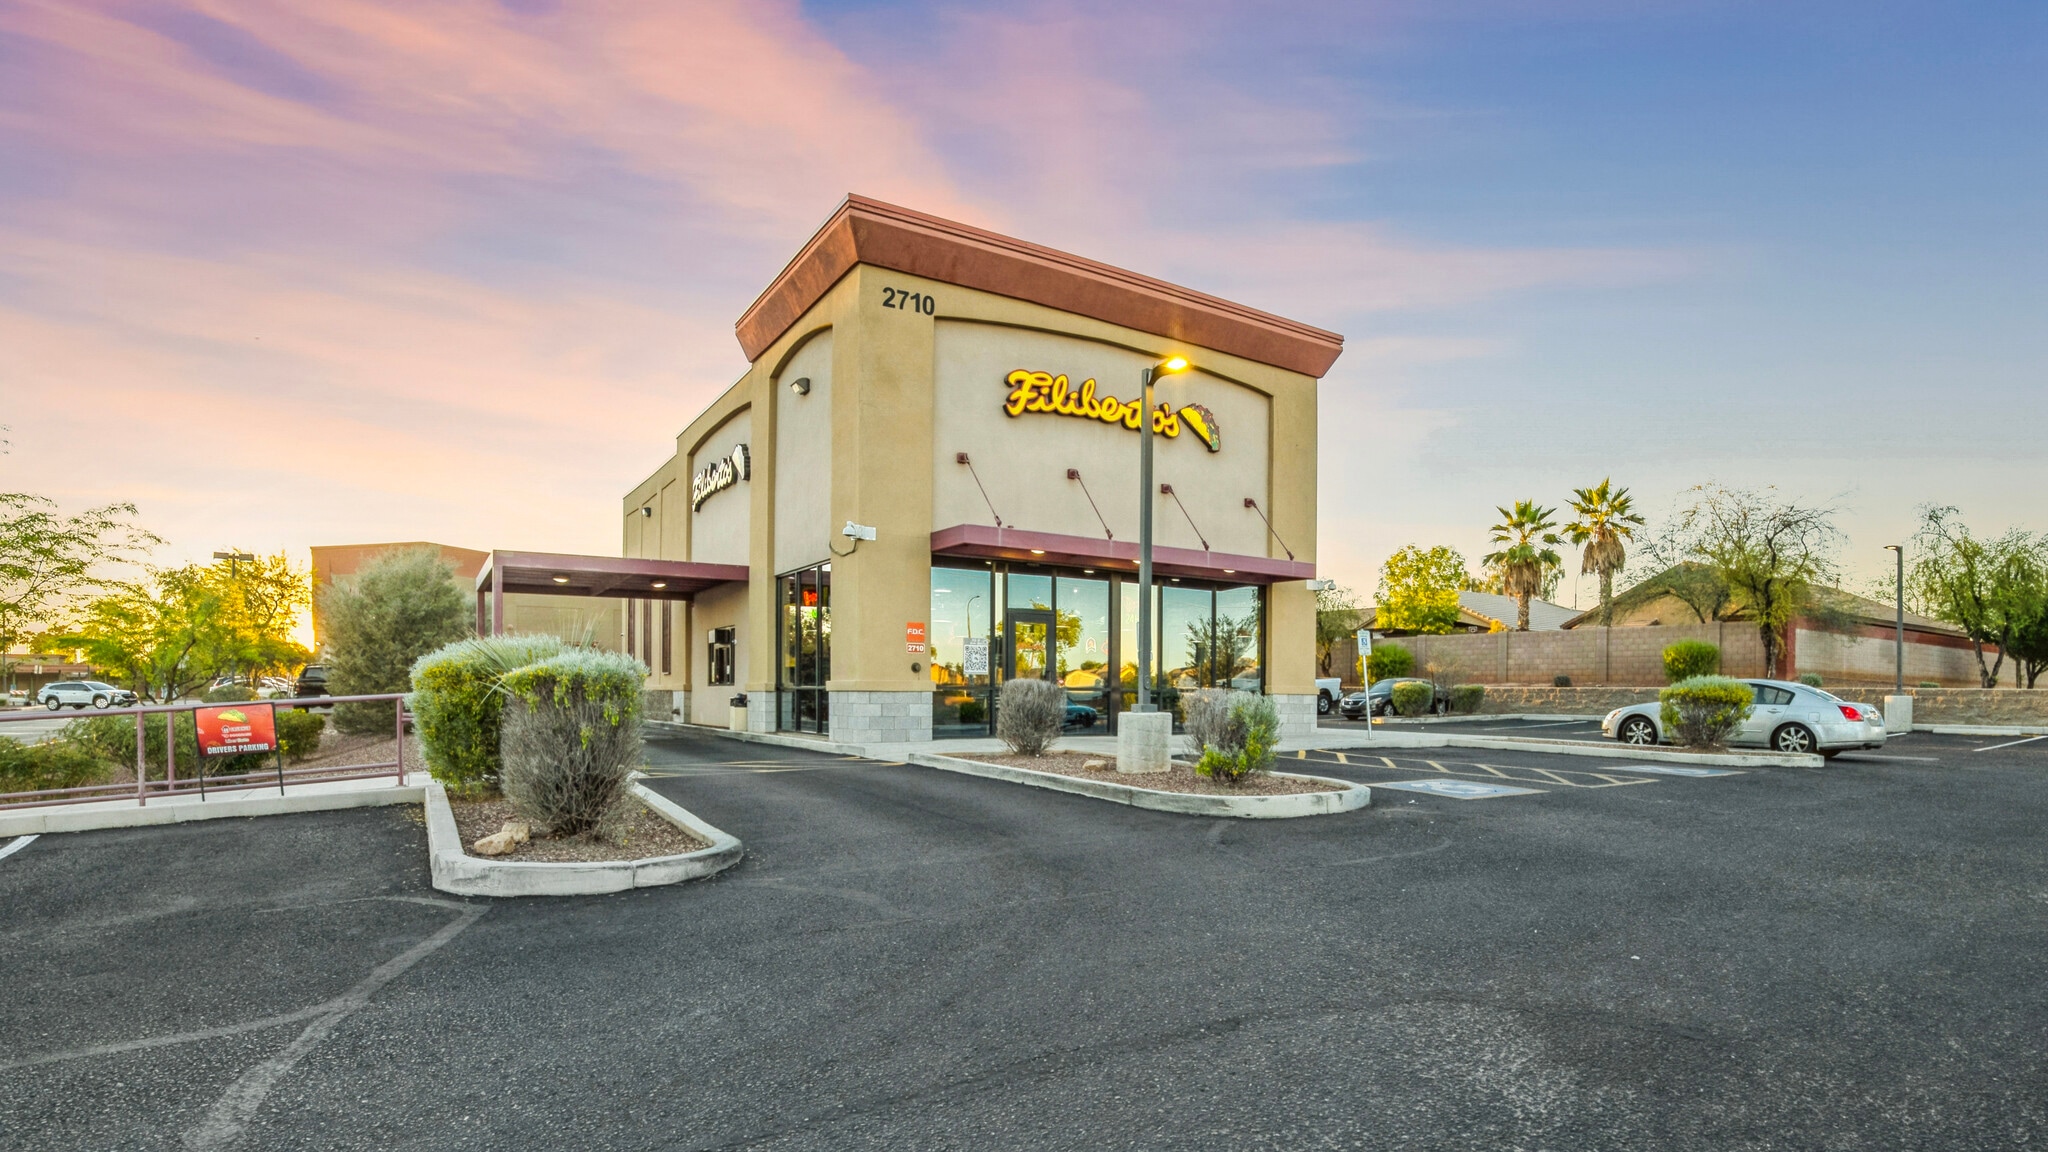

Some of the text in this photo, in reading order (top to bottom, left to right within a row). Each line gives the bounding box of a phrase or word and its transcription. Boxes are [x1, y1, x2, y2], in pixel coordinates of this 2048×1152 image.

[882, 286, 935, 316] 2710
[207, 743, 269, 754] DRIVERS PARKING
